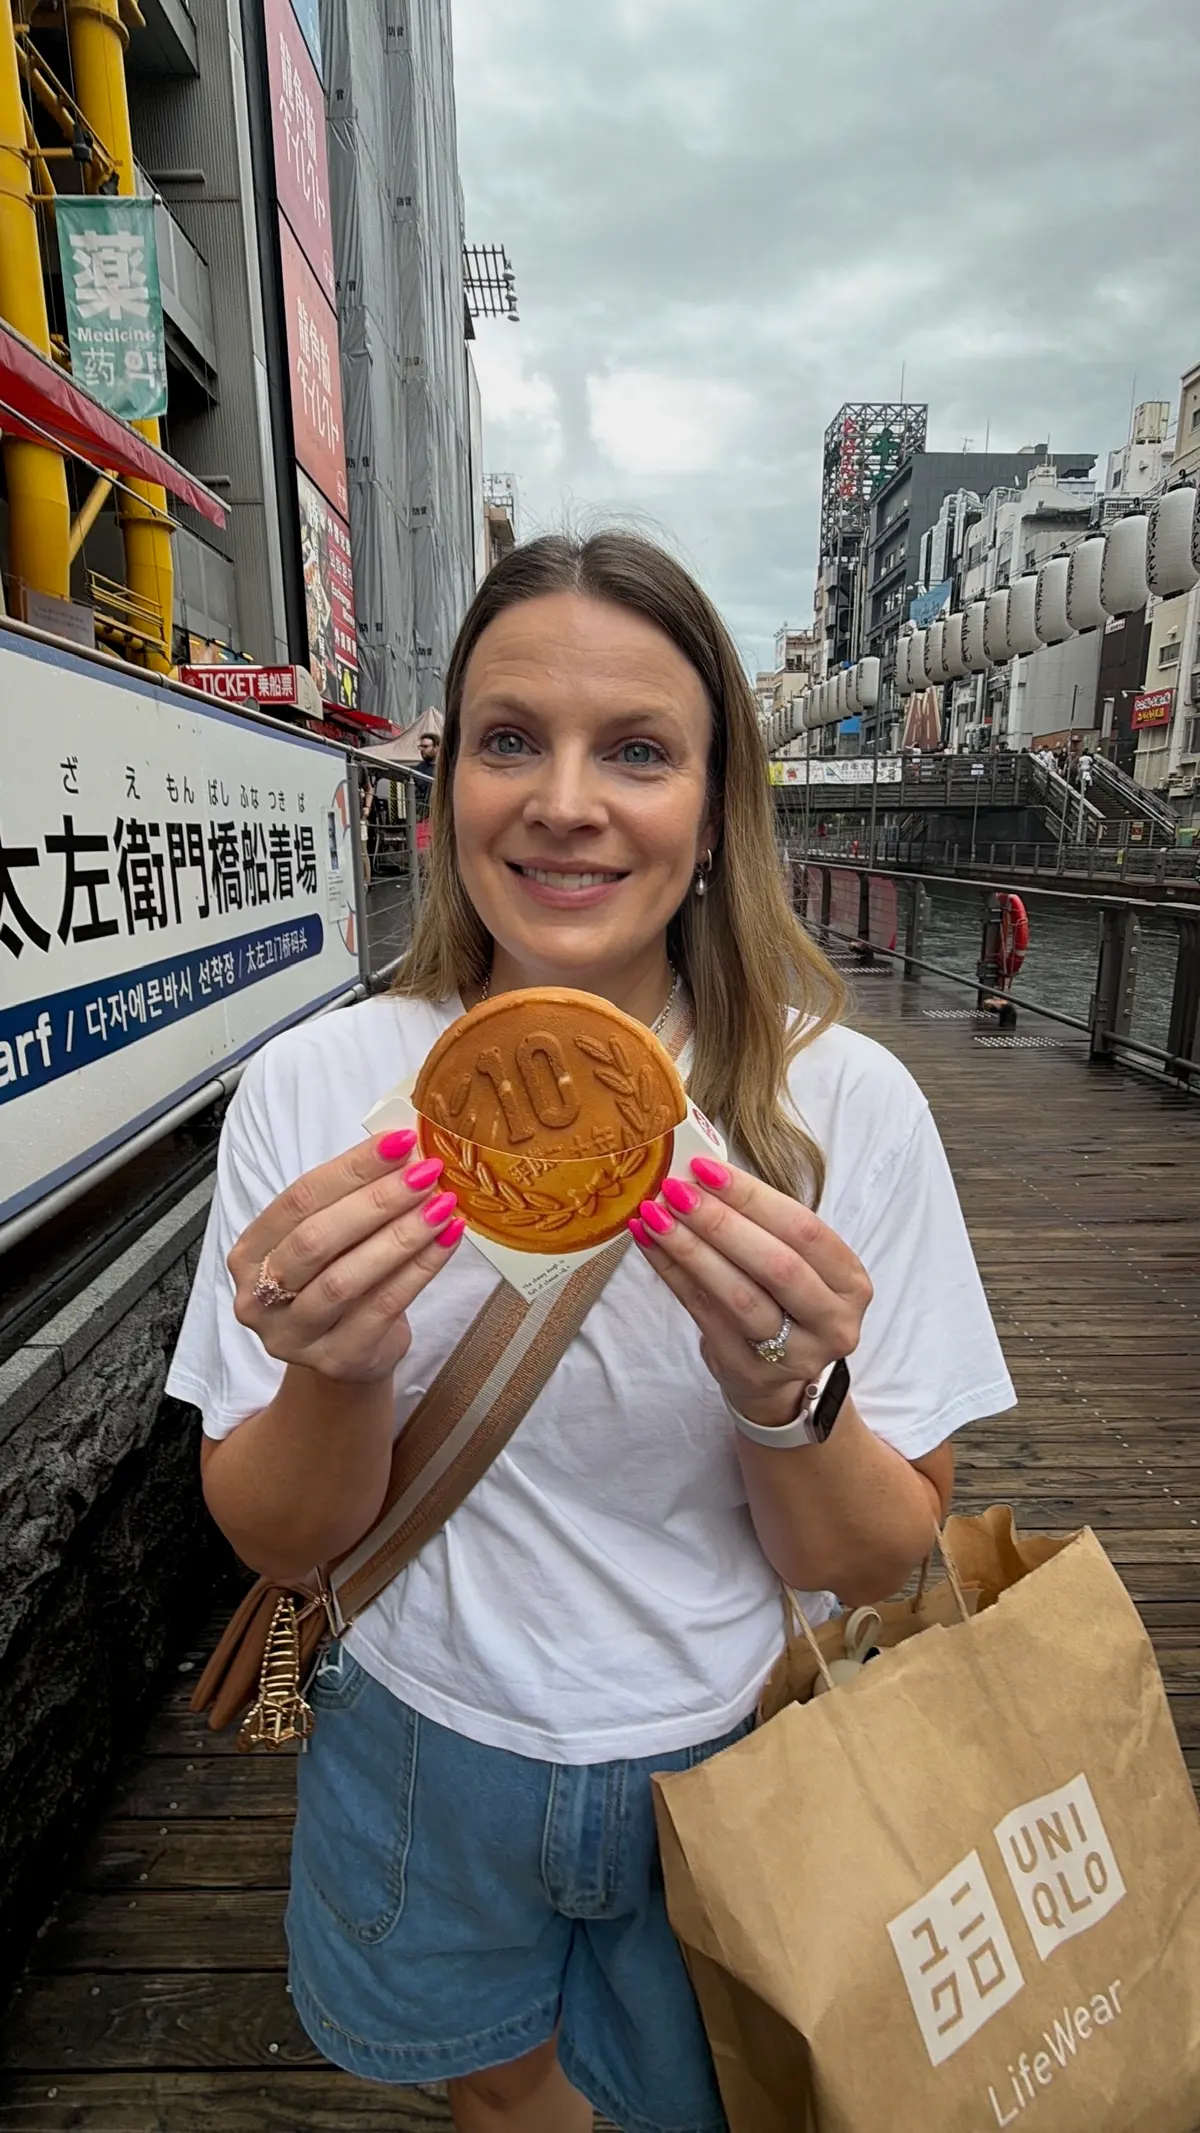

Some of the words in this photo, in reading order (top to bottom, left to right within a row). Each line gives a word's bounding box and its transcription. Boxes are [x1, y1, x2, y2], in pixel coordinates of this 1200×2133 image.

[279, 95, 326, 228] ダイレクト
[69, 229, 150, 320] 薬
[77, 326, 155, 343] Medicine
[81, 347, 115, 387] 药
[124, 350, 155, 388] 약
[198, 673, 257, 697] TICKET
[257, 673, 293, 697] 乗船票
[60, 757, 79, 794] ざ
[125, 766, 140, 800] え
[166, 773, 195, 804] もん
[207, 780, 230, 808] ばし
[240, 785, 260, 808] ふな
[268, 791, 286, 811] つき
[298, 793, 305, 813] ば
[0, 1011, 52, 1088] arf
[85, 966, 193, 1041] 다자에몬바시
[199, 953, 236, 996] 선착장
[246, 929, 308, 975] 太左卫门桥码头
[477, 1031, 581, 1144] 10
[1009, 1802, 1088, 1874] UNI
[911, 1881, 986, 1975] ユニ
[1031, 1851, 1109, 1930] QLO
[930, 1937, 1006, 2036] クロ
[987, 1979, 1122, 2129] LifeWear
